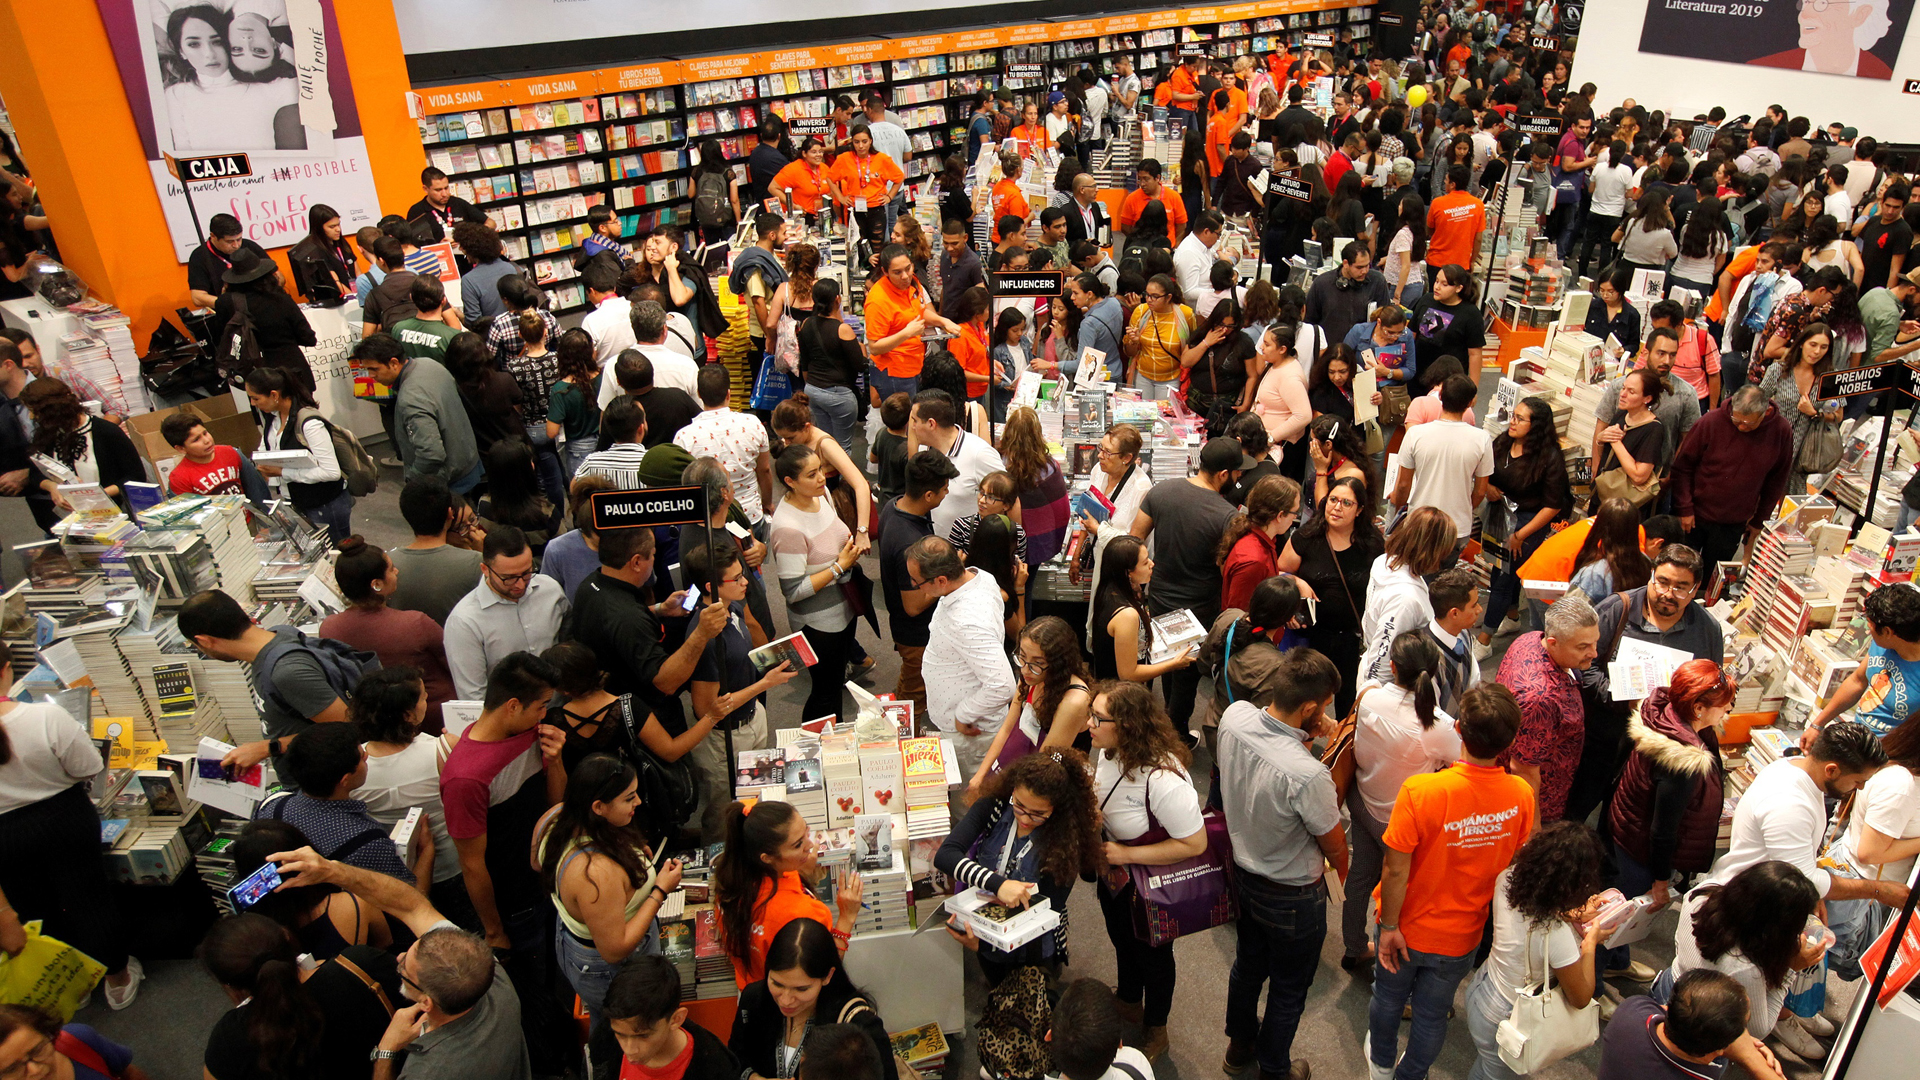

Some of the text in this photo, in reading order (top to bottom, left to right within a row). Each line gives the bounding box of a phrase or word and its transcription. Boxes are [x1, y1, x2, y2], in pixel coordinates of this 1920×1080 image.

[1664, 0, 1763, 18] Literatura 2019
[308, 27, 328, 73] Y POCHÉ
[836, 43, 883, 55] LIBROS PARA CUIDAR
[901, 40, 918, 48] JUVENIL
[922, 37, 942, 46] NECESITO
[915, 46, 935, 54] CONSEJO
[1532, 37, 1554, 50] CAJA
[774, 51, 811, 62] CLAVES PARA
[860, 52, 873, 60] HIJOS
[689, 58, 750, 71] CLAVES PARA MEJORAR
[770, 58, 816, 70] SENTIRTE MEJOR
[619, 68, 661, 79] LIBROS PARA
[698, 67, 742, 78] TUS RELACIONES
[300, 63, 313, 100] CALLE
[528, 80, 577, 96] VIDA SANA
[618, 76, 663, 89] TU BIENESTAR
[428, 91, 483, 107] VIDA SANA
[190, 156, 240, 178] CAJA
[192, 179, 226, 194] novela
[227, 178, 240, 188] de
[241, 175, 266, 186] amor
[1270, 182, 1309, 199] PÉREZ-REVERTE
[1280, 178, 1301, 189] ARTURO
[261, 199, 278, 219] SI
[287, 194, 308, 213] ES
[249, 211, 308, 241] CONTI
[1000, 280, 1055, 289] INFLUENCERS
[400, 328, 442, 348] TECATE
[1834, 367, 1882, 385] PREMIOS
[1500, 382, 1516, 398] ISAIAH
[1838, 381, 1873, 395] NOBEL
[1497, 391, 1513, 408] BERLIN
[604, 498, 695, 516] PAULO COELHO
[1867, 655, 1887, 668] BIG
[155, 671, 191, 680] LATITUDES
[158, 680, 187, 689] ALBERTO
[623, 704, 633, 728] REACTION
[1865, 715, 1893, 734] GANG
[867, 765, 898, 773] COELHO
[833, 780, 856, 788] PAULO
[1443, 806, 1519, 832] VOLVÁMONOS
[1459, 822, 1503, 839] LIBROS
[1161, 863, 1211, 880] FERIA INTERNACIONAL
[1172, 876, 1187, 884] LIBRO
[659, 928, 690, 940] Coelho
[661, 923, 687, 933] Paulo
[925, 1027, 938, 1054] KING
[930, 1023, 945, 1050] STEPHEN
